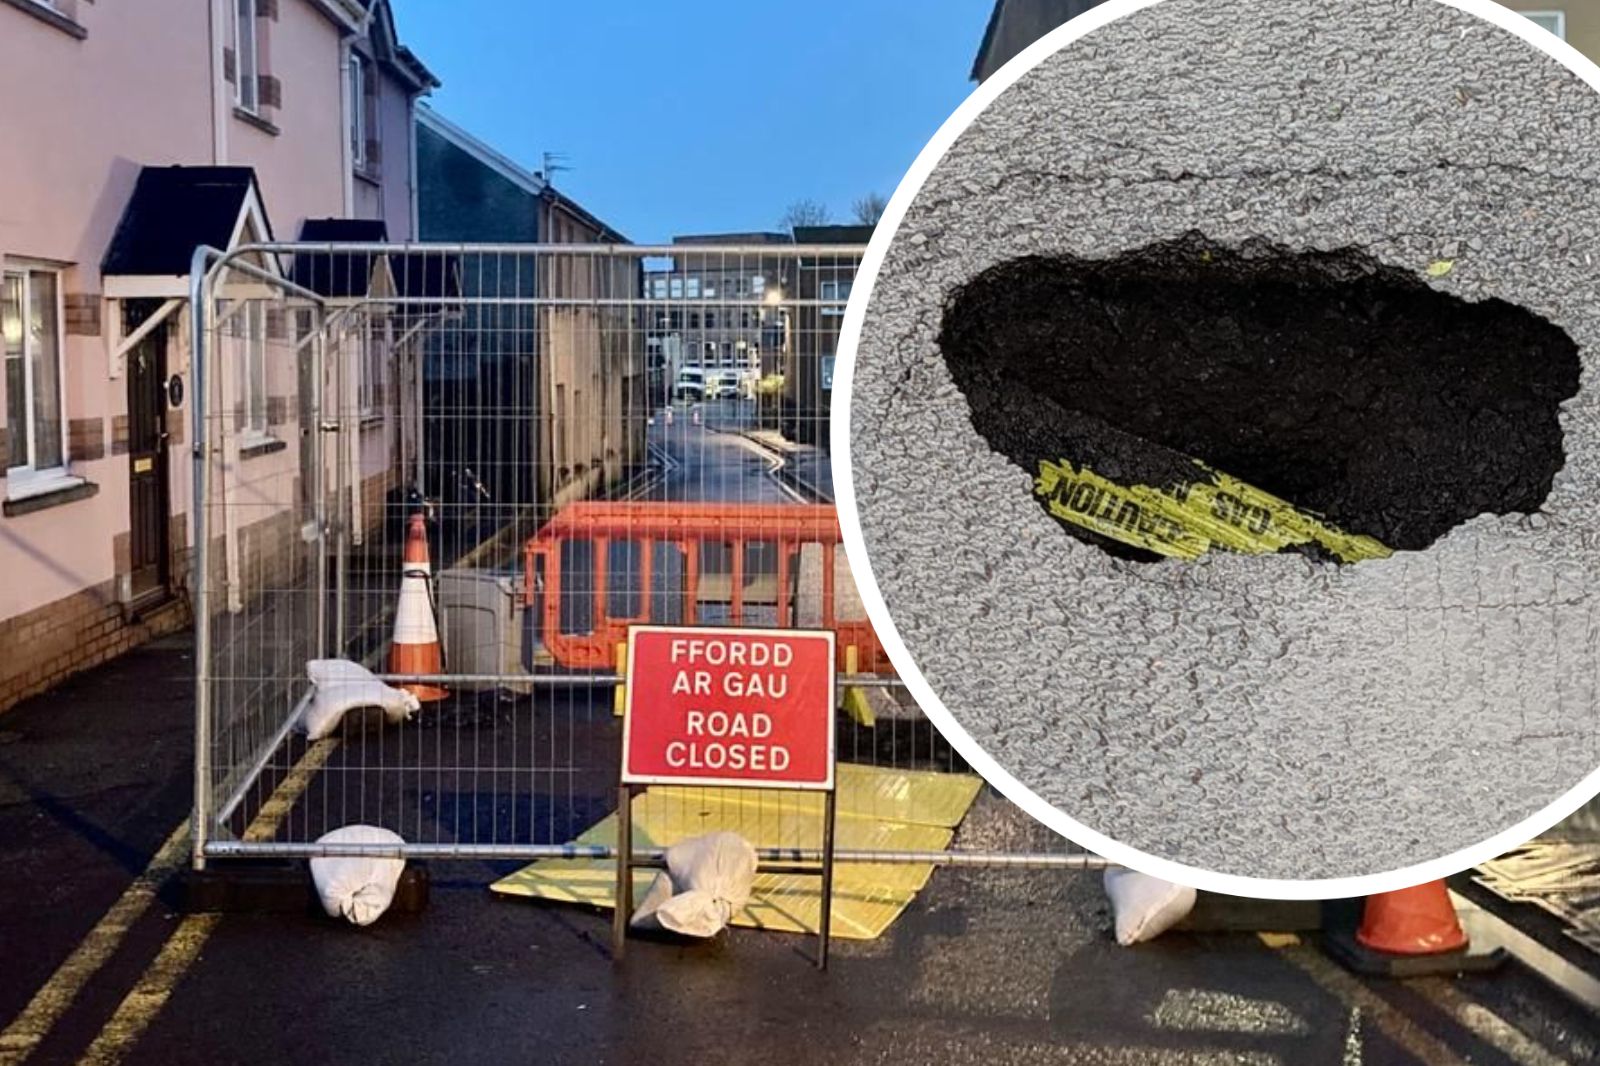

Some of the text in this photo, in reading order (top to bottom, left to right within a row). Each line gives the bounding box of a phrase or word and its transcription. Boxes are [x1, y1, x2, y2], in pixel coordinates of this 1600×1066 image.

[1052, 476, 1183, 542] CAUTION
[1210, 491, 1271, 535] GAS
[671, 639, 793, 667] FFORDD
[672, 670, 788, 698] AR GAU
[687, 711, 772, 738] ROAD
[666, 741, 790, 771] CLOSED
